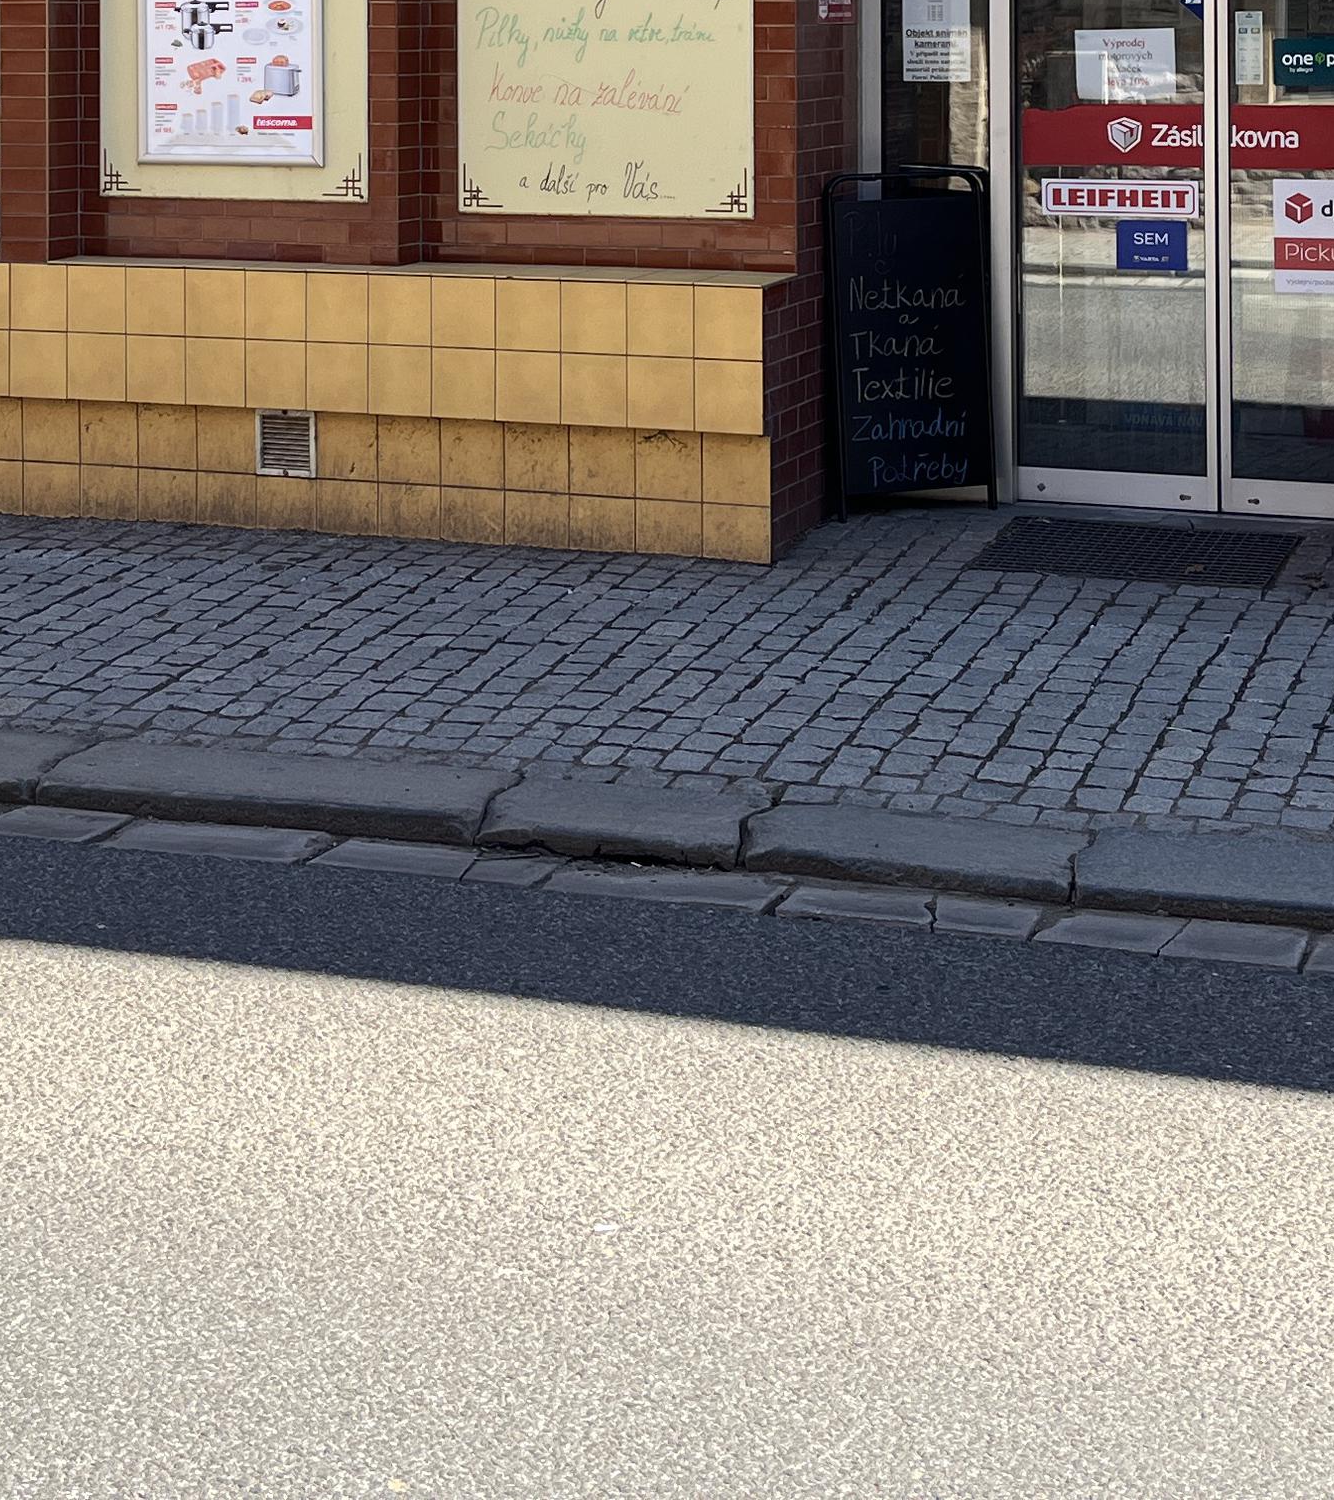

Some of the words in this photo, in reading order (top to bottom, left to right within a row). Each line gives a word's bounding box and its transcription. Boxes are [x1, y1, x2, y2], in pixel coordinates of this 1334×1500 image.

[599, 28, 619, 43] na
[906, 29, 934, 38] Objekt
[1102, 38, 1146, 49] Výprodej
[1282, 53, 1314, 66] one
[554, 84, 581, 105] na
[484, 110, 588, 164] Sekáčky
[518, 175, 530, 189] a
[539, 162, 580, 196] další
[585, 182, 609, 203] pro
[1051, 188, 1190, 210] LEIFHEIT
[1133, 232, 1169, 246] SEM
[850, 273, 968, 312] Netkaná
[849, 324, 946, 360] Tkaná
[852, 367, 956, 403] Textilie
[852, 407, 968, 442] Zahradní
[867, 452, 969, 488] Potřeby
